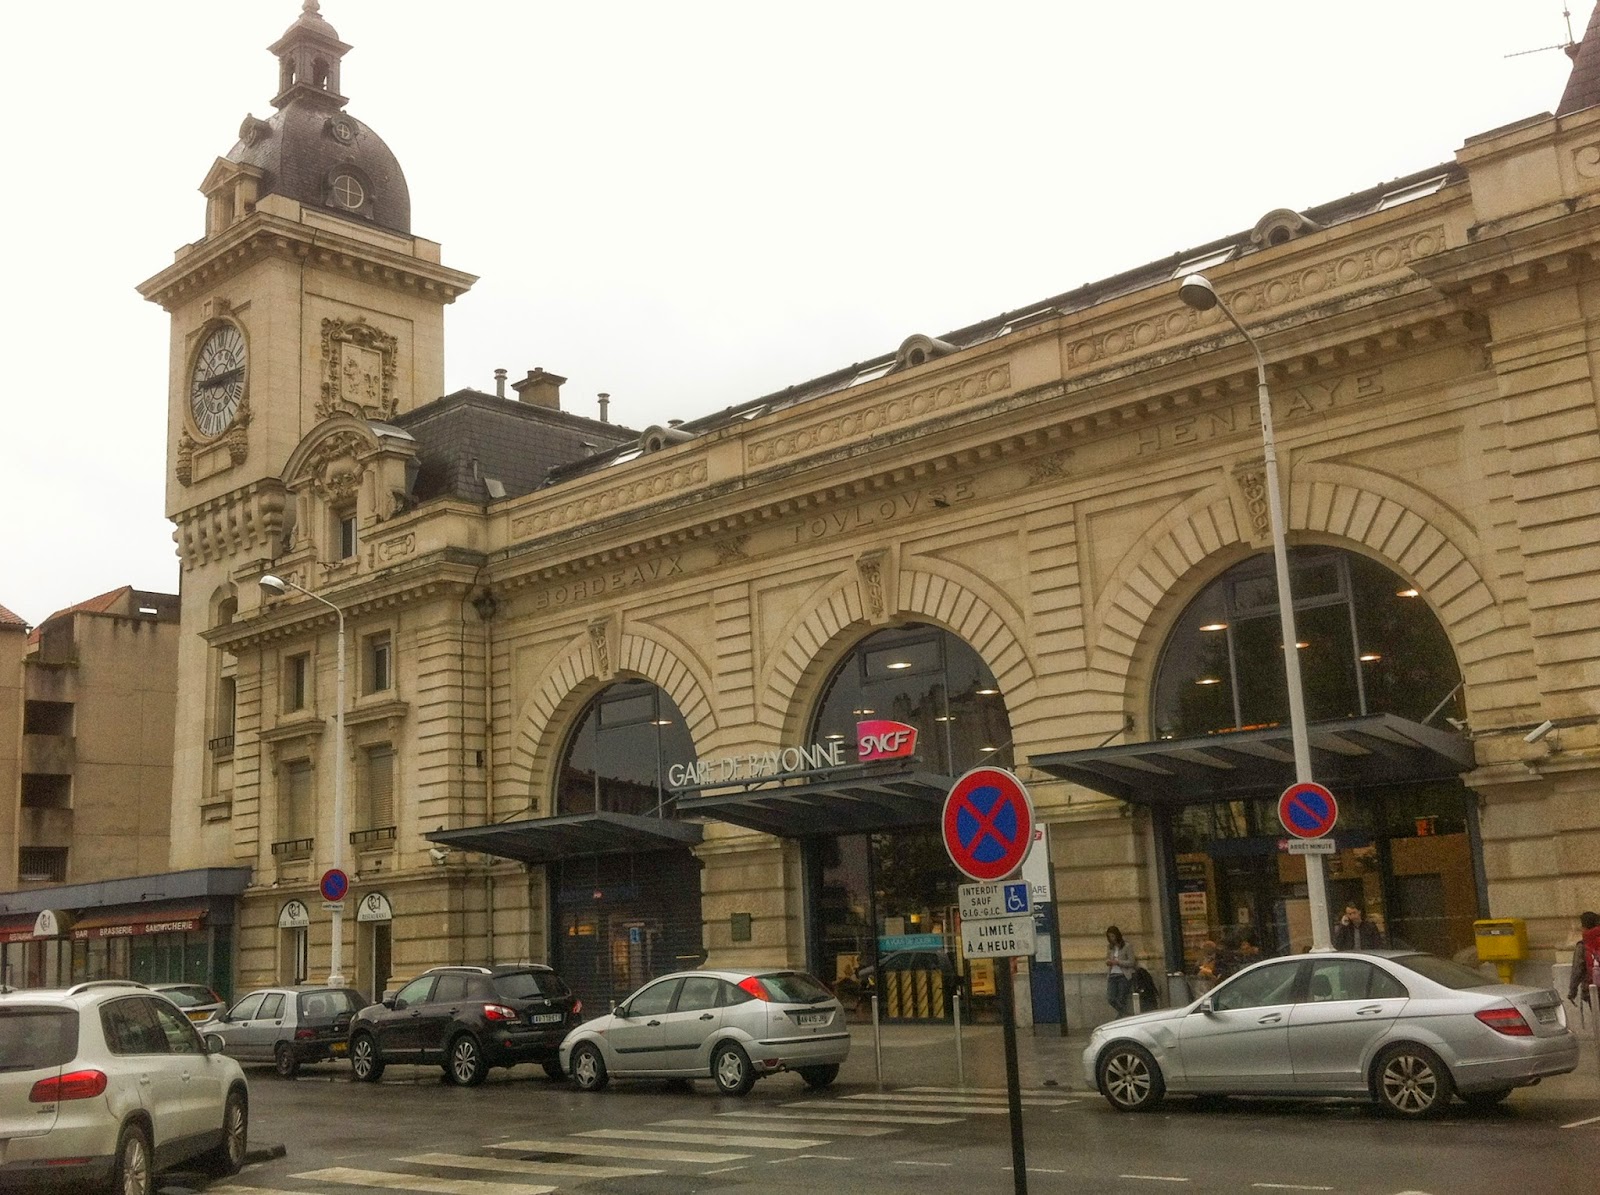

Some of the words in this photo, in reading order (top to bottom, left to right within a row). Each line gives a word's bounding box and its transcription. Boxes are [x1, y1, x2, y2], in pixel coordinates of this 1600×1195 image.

[1136, 368, 1384, 455] HENDAYE
[788, 474, 976, 544] TOVLOVSE
[536, 555, 684, 611] BORDEAVX
[859, 730, 911, 757] SNCF
[668, 759, 715, 787] GARE
[720, 756, 742, 780] DE
[749, 740, 847, 777] BAYONNE
[962, 885, 998, 896] INTERDIT
[1032, 885, 1047, 894] ARE
[971, 896, 992, 906] SAUF
[75, 930, 88, 939] BAR
[99, 925, 133, 937] BRASSERIE
[145, 920, 193, 933] SANDWICHERIE
[979, 922, 1014, 937] LIMITÉ
[967, 940, 973, 953] À
[977, 942, 984, 952] 4
